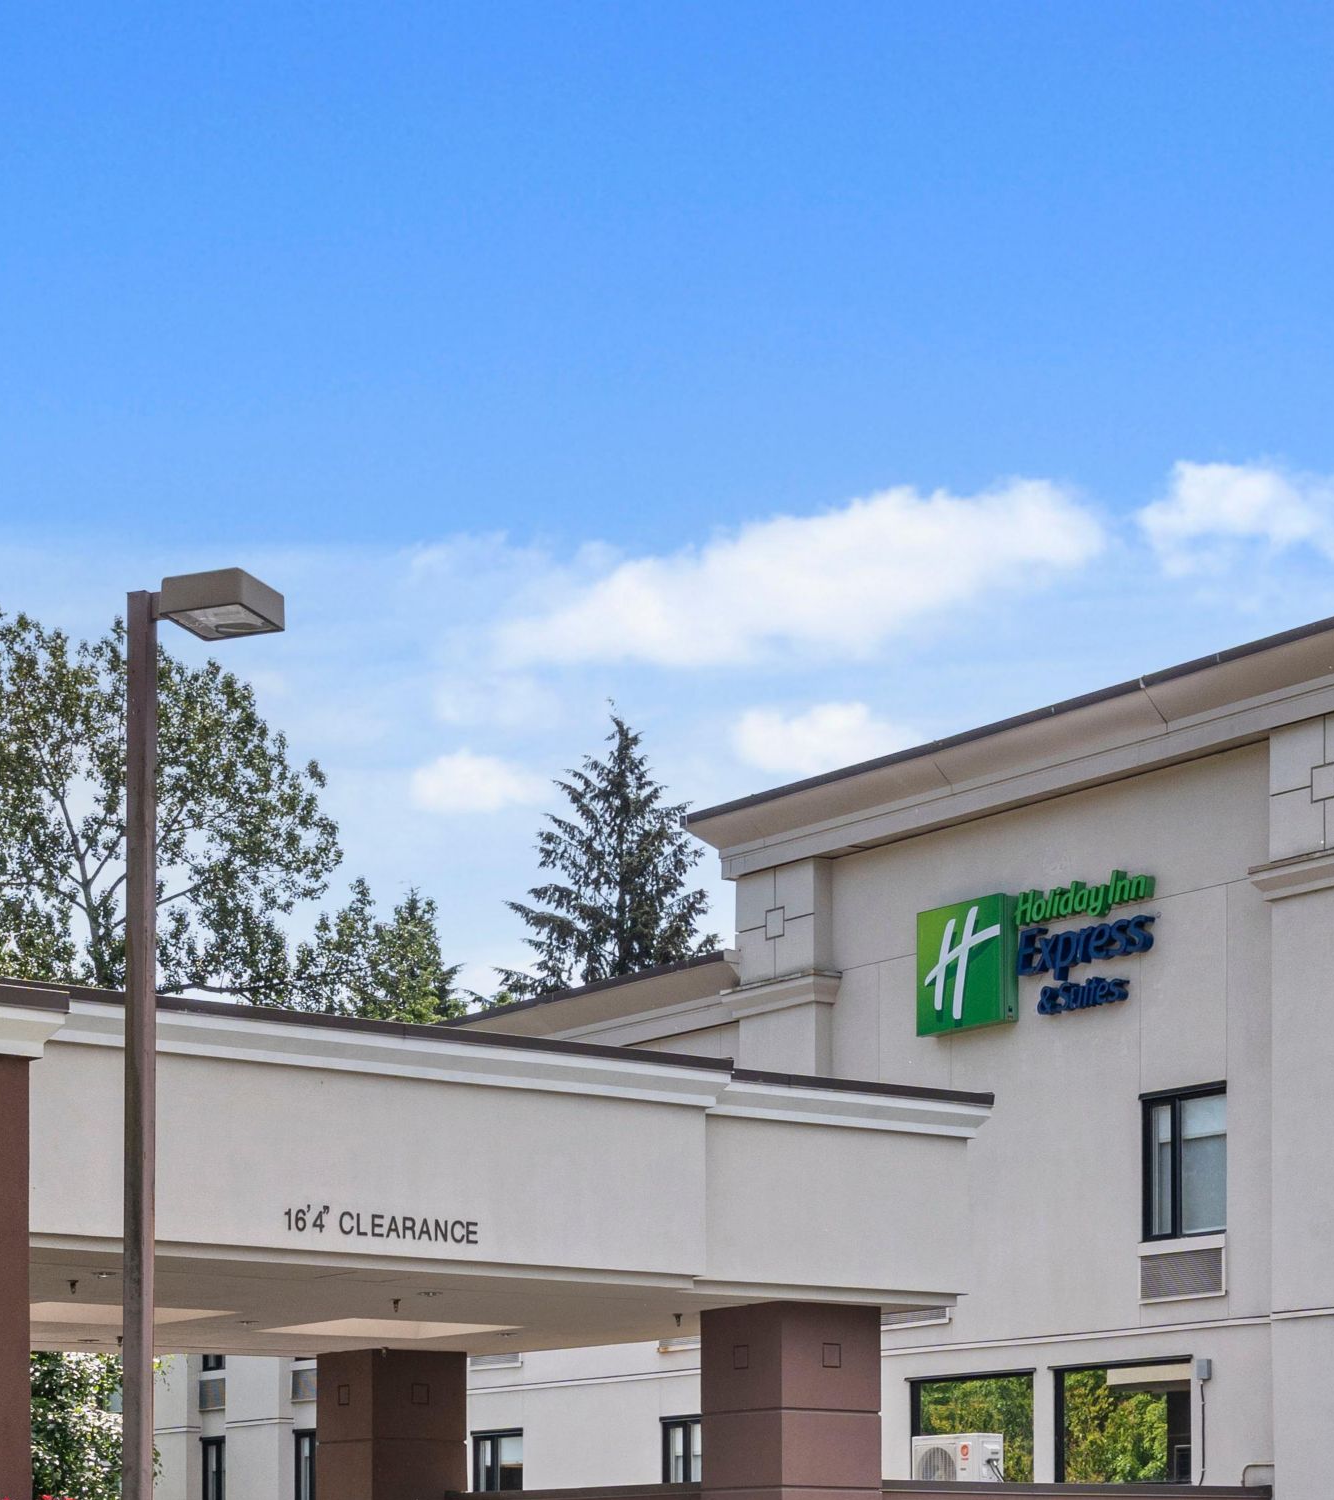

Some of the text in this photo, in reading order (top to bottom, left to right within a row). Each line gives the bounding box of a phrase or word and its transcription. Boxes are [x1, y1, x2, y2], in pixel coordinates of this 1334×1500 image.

[1014, 869, 1156, 926] Holiday Inn
[1037, 976, 1131, 1015] & Suites
[338, 1211, 479, 1245] CLEARANCE
